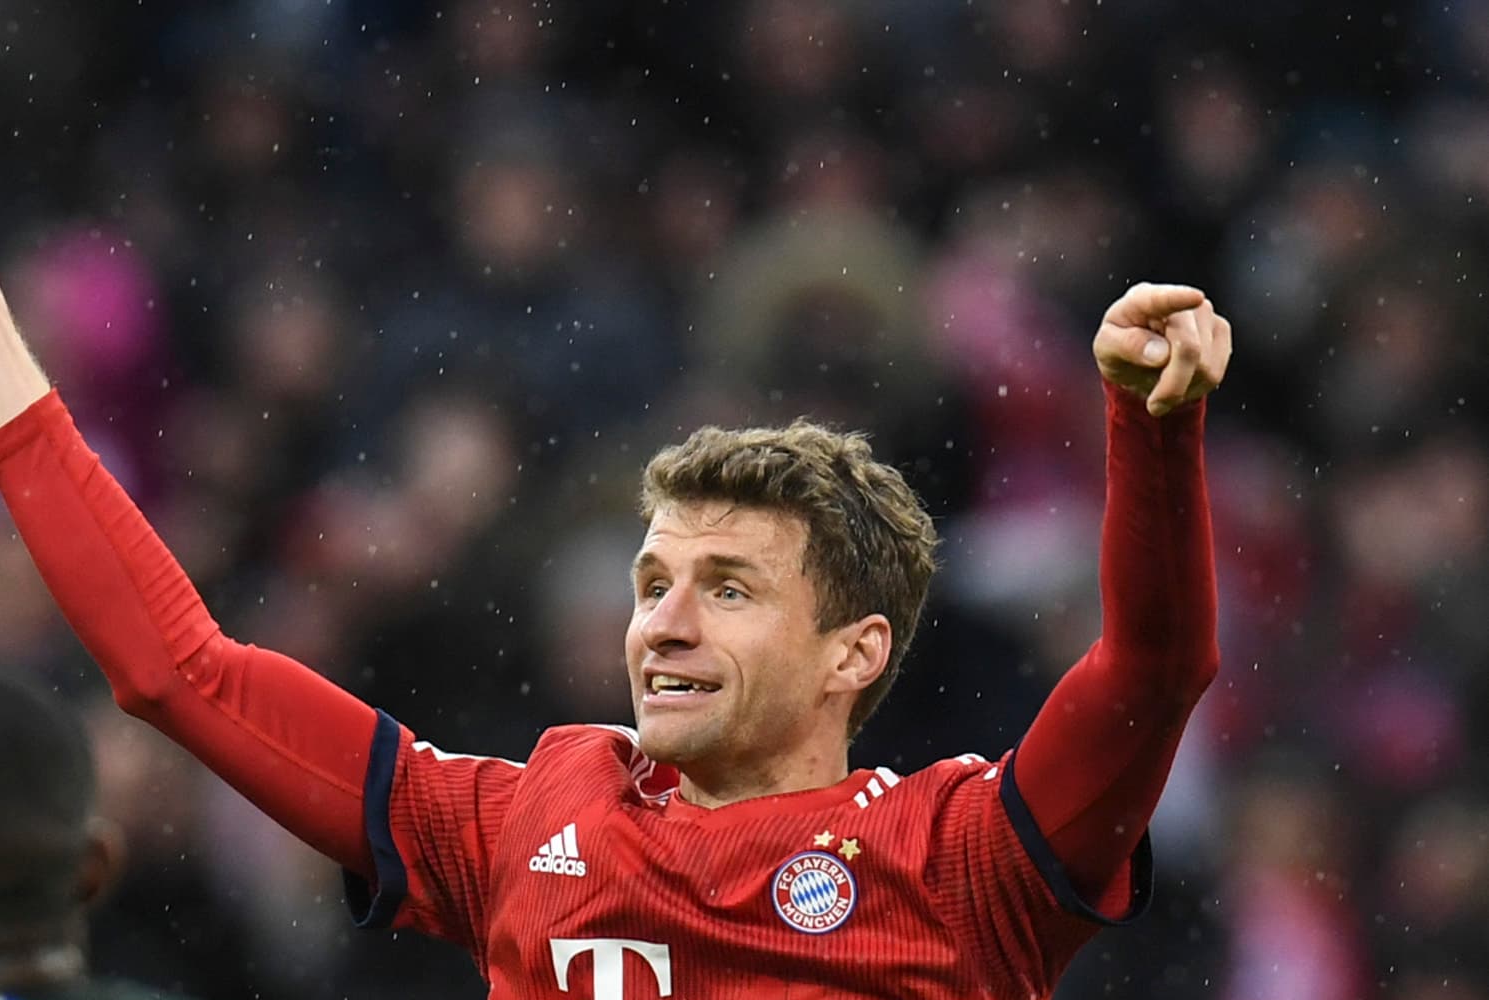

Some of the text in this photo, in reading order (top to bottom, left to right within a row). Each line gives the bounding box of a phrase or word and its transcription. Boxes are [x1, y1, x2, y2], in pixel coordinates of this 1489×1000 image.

[528, 853, 587, 877] adidas
[778, 858, 847, 891] FC BAYERN
